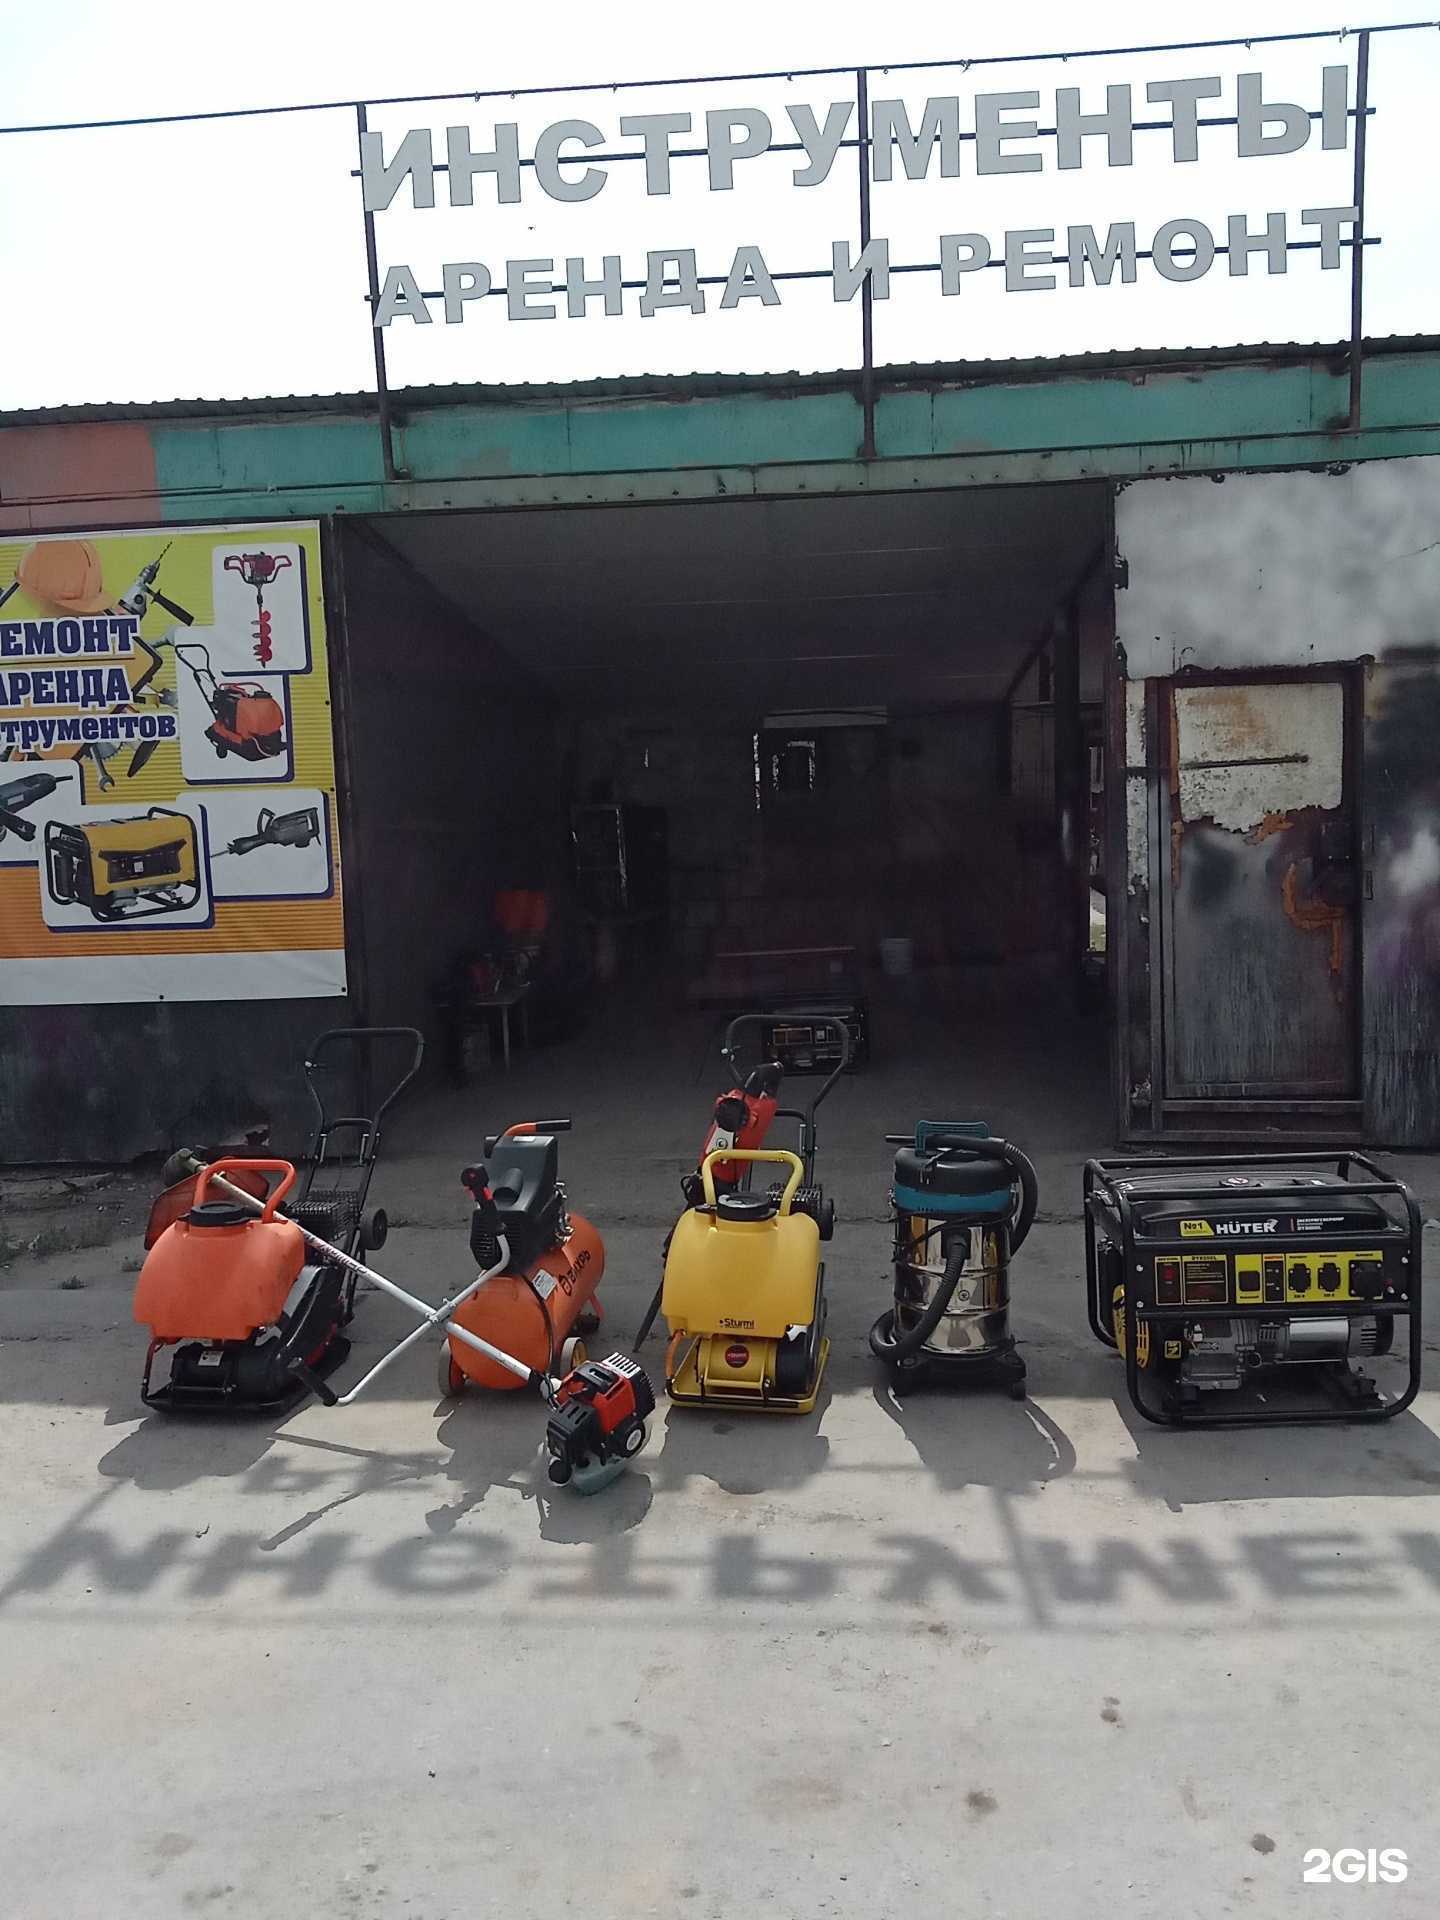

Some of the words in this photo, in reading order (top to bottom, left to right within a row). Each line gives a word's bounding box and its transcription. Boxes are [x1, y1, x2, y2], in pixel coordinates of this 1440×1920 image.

[360, 65, 1348, 212] ИНСТРУМЕНТЫ
[373, 245, 782, 328] АРЕНДА
[831, 238, 890, 302] И
[940, 206, 1360, 296] РЕМОНТ
[1216, 1220, 1278, 1234] HÜTER
